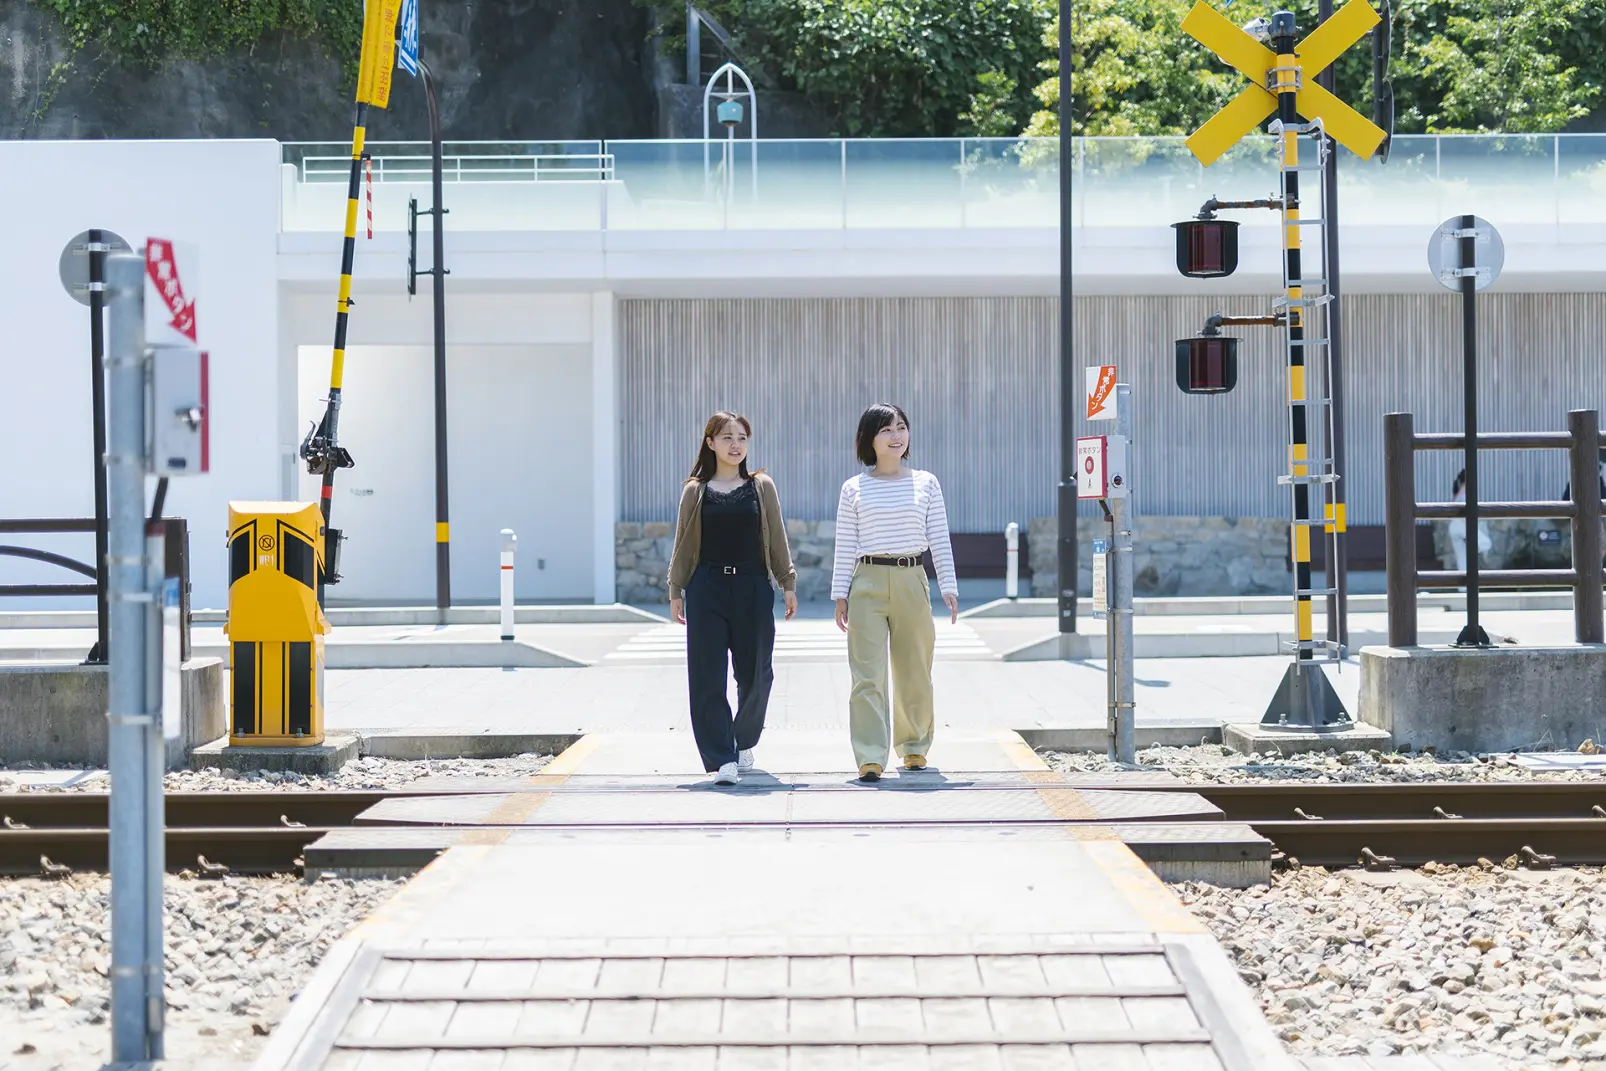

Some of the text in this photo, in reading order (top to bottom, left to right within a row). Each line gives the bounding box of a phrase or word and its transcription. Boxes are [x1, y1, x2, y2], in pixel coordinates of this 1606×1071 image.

[1092, 367, 1115, 410] 非常ボタン
